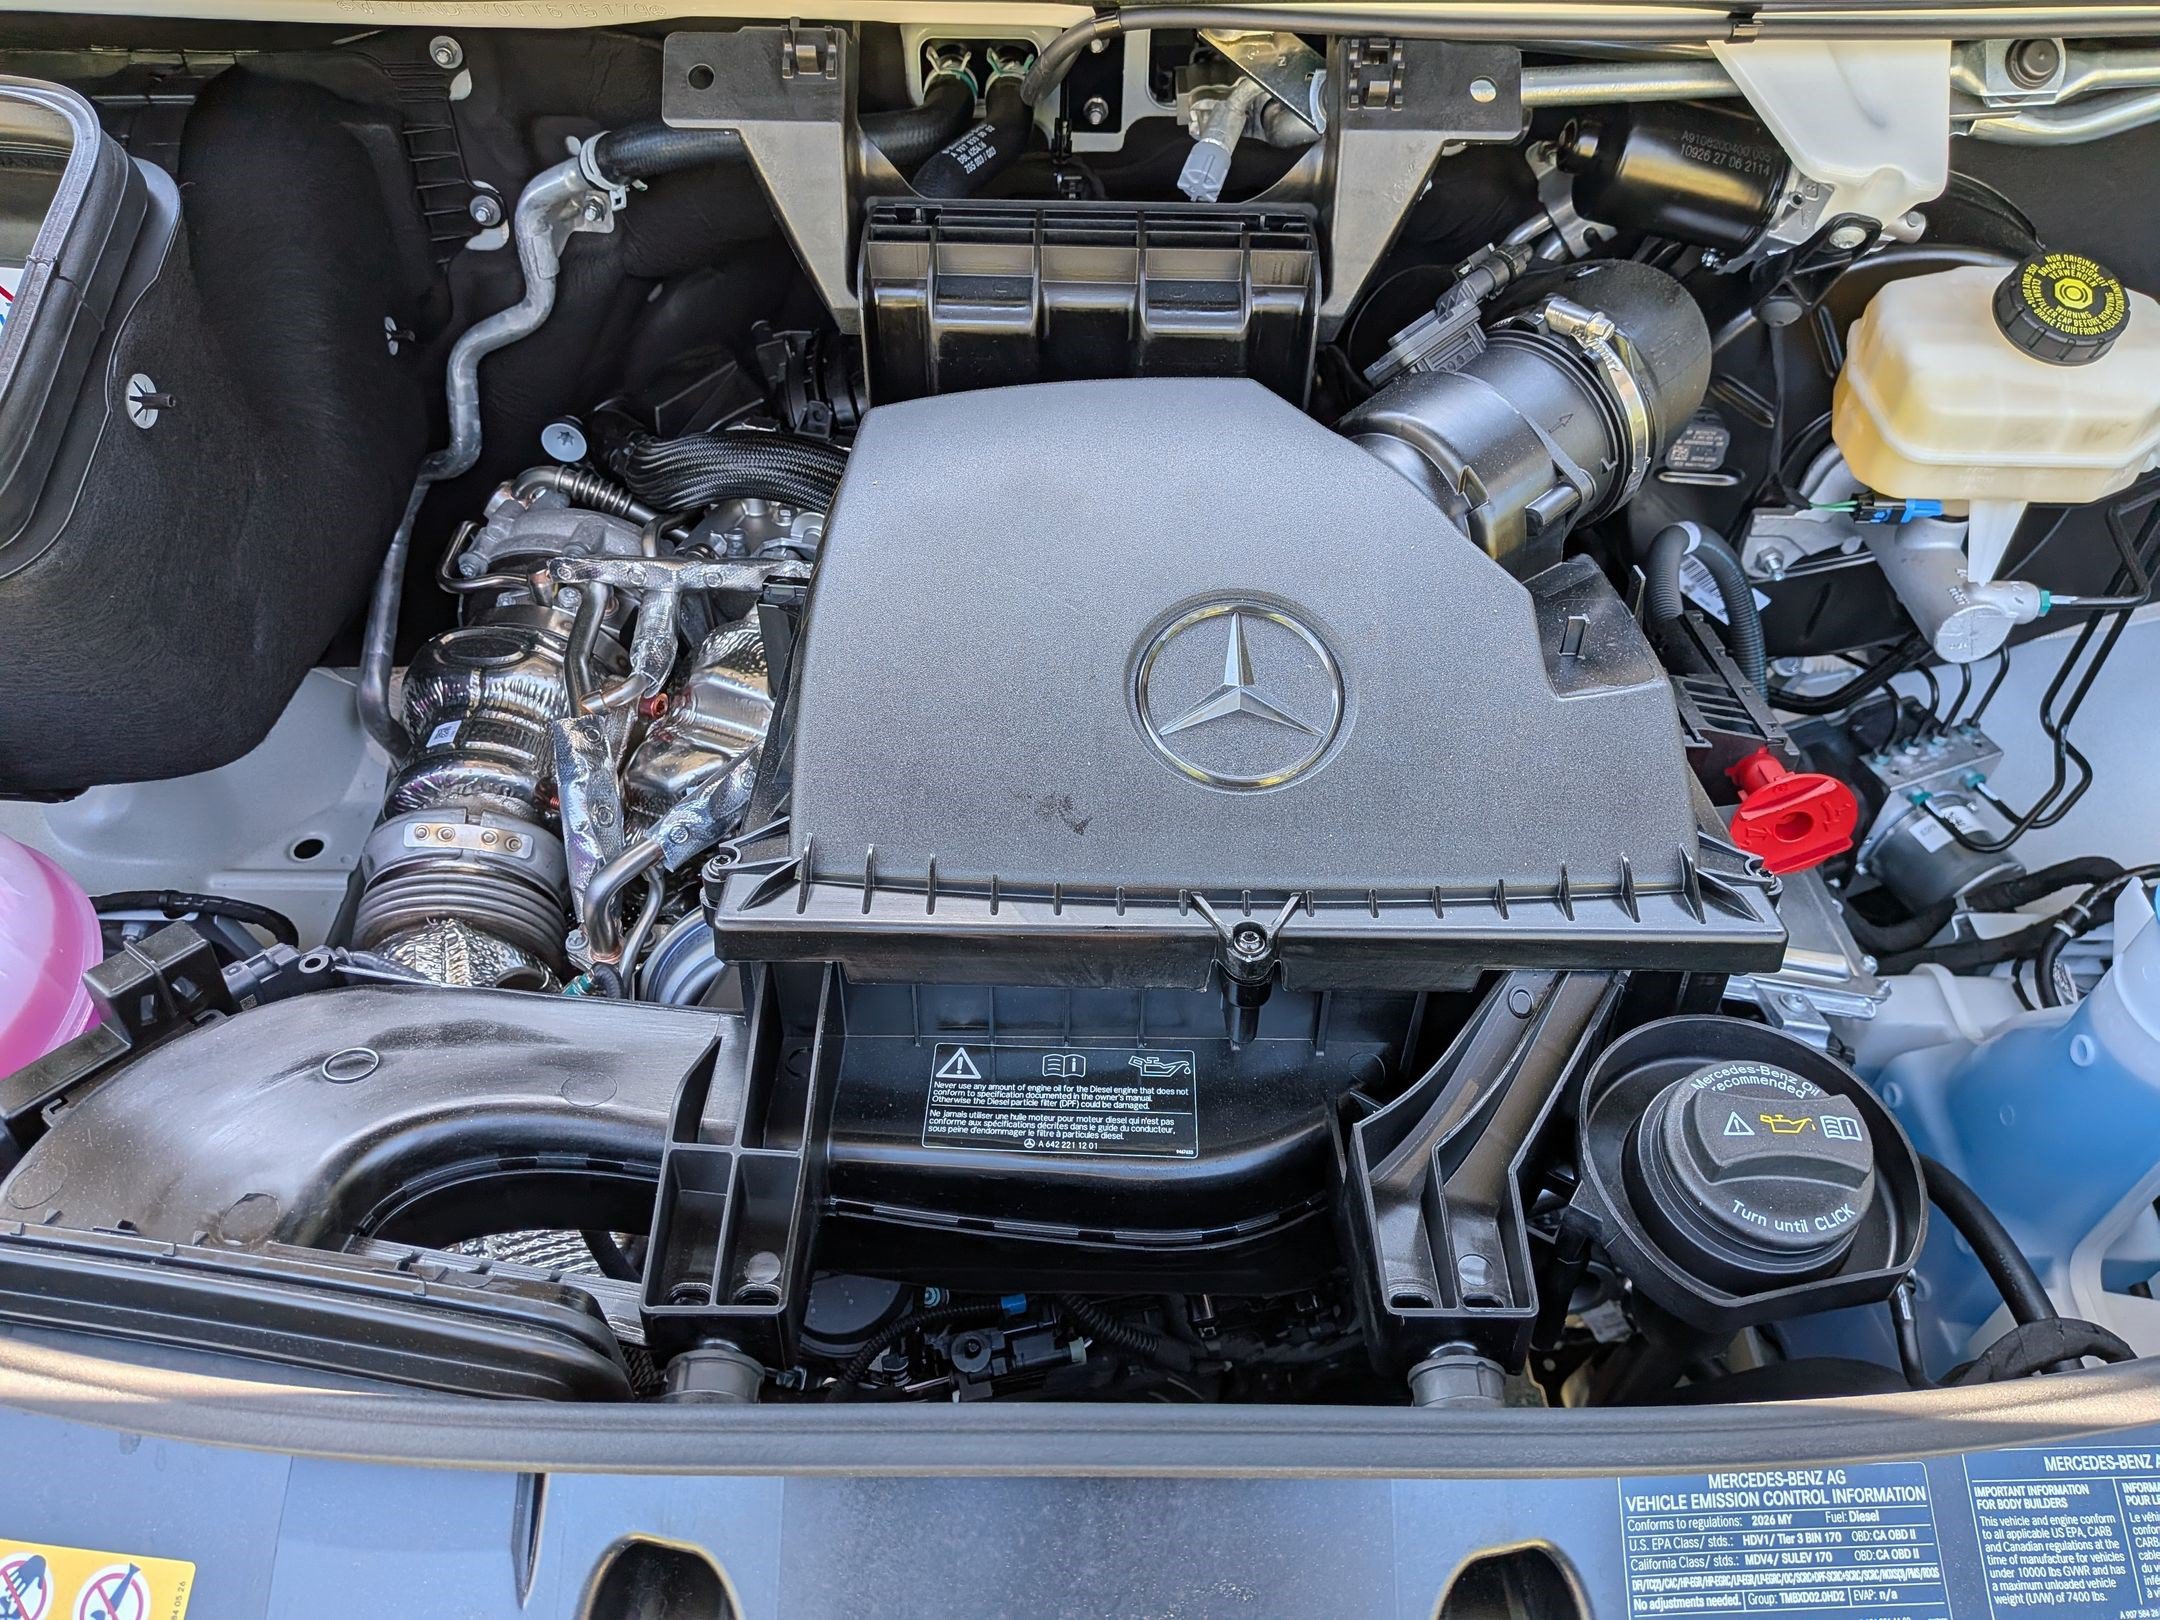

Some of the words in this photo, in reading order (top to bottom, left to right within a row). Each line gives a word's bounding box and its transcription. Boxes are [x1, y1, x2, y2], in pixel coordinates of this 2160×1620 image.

[1680, 144, 1710, 161] 10926
[1713, 152, 1727, 165] 27
[1729, 156, 1742, 169] 06
[2026, 264, 2039, 275] USE
[2045, 254, 2061, 263] NUR
[2064, 254, 2099, 272] ORIGINAL
[2022, 274, 2032, 289] ONLY
[2049, 269, 2098, 287] VERWENDEN
[2032, 279, 2042, 298] CLEAN
[2108, 279, 2124, 312] CONTAINER
[2036, 298, 2057, 318] FILLER
[2056, 305, 2091, 318] WARNING
[2099, 292, 2114, 321] REMOVING
[2034, 308, 2056, 326] BRAKE
[2058, 315, 2072, 324] CAP
[2074, 317, 2102, 327] BEFORE
[2103, 311, 2123, 330] SEALED
[2056, 322, 2078, 334] FLUID
[2079, 326, 2100, 335] FROM
[934, 1080, 956, 1088] Never
[987, 1082, 1015, 1090] amount
[1027, 1083, 1051, 1092] engine
[1089, 1085, 1112, 1093] Diesel
[1113, 1086, 1138, 1095] engine
[1691, 1065, 1798, 1091] Mercedes-Benz
[1802, 1082, 1821, 1097] Oil
[1712, 1075, 1806, 1099] recommended
[932, 1095, 971, 1103] Otherwise
[986, 1097, 1009, 1105] Diesel
[1010, 1097, 1038, 1107] particle
[1059, 1099, 1079, 1108] (DPF)
[1080, 1099, 1100, 1107] could
[1113, 1100, 1149, 1110] damaged.
[976, 1089, 1024, 1099] specification
[1025, 1090, 1071, 1099] documented
[1094, 1092, 1124, 1100] owner's
[1125, 1093, 1152, 1101] manual.
[942, 1109, 967, 1119] jamais
[968, 1110, 993, 1118] utiliser
[1028, 1112, 1055, 1121] moteur
[1076, 1114, 1103, 1123] moteur
[1105, 1115, 1127, 1123] diesel
[1140, 1117, 1159, 1125] n'est
[929, 1117, 966, 1125] conforme
[983, 1118, 1035, 1129] spécifications
[1036, 1120, 1068, 1129] décrites
[1097, 1122, 1118, 1133] guide
[1130, 1124, 1175, 1134] conducteur,
[947, 1125, 968, 1135] peine
[969, 1126, 1026, 1137] d'endommager
[1036, 1128, 1054, 1136] filtre
[1062, 1129, 1099, 1140] particules
[1100, 1130, 1124, 1139] diesel.
[1045, 1140, 1059, 1148] 642
[1731, 1200, 1766, 1226] Turn
[1774, 1220, 1808, 1233] until
[1814, 1203, 1855, 1230] CLICK
[2043, 1453, 2152, 1471] MERCEDES-BENZ
[1708, 1469, 1823, 1488] MERCEDES-BENZ
[1825, 1469, 1846, 1484] AG
[1974, 1485, 2026, 1497] IMPORTANT
[2026, 1483, 2089, 1495] INFORMATION
[1625, 1493, 1688, 1511] VEHICLE
[1689, 1491, 1760, 1508] EMISSION
[1762, 1488, 1830, 1506] CONTROL
[1831, 1485, 1926, 1503] INFORMATION
[1976, 1499, 1996, 1509] FOR
[1996, 1498, 2022, 1509] BODY
[2023, 1497, 2068, 1508] BUILDERS
[2125, 1495, 2151, 1505] POUR
[1626, 1516, 1674, 1530] Conforms
[1675, 1516, 1686, 1528] to
[1687, 1514, 1742, 1531] regulations:
[1751, 1514, 1775, 1525] 2026
[1777, 1513, 1792, 1524] MY
[1825, 1510, 1847, 1522] Fuel:
[1848, 1509, 1879, 1521] Diesel
[1979, 1515, 1998, 1526] This
[1998, 1514, 2030, 1525] vehicle
[2031, 1514, 2048, 1525] and
[2049, 1513, 2079, 1527] engine
[2079, 1512, 2116, 1524] conform
[1742, 1533, 1776, 1546] HDV1/
[1776, 1532, 1795, 1544] Tier
[1796, 1532, 1803, 1543] 3
[1804, 1532, 1822, 1543] BIN
[1824, 1531, 1842, 1542] 170
[1851, 1529, 1872, 1541] OBD:
[1872, 1529, 1887, 1540] CA
[1887, 1528, 1908, 1540] OBD
[1993, 1528, 2004, 1539] all
[2005, 1526, 2050, 1541] applicable
[2050, 1526, 2065, 1537] US
[2065, 1525, 2086, 1538] EPA,
[2086, 1525, 2112, 1536] CARB
[1628, 1538, 1649, 1550] U.S.
[1651, 1537, 1671, 1549] EPA
[1672, 1536, 1705, 1549] Class/
[1707, 1535, 1733, 1547] stds.:
[1984, 1541, 2002, 1552] and
[2002, 1539, 2044, 1551] Canadian
[2044, 1538, 2094, 1553] regulations
[2104, 1538, 2120, 1549] the
[1630, 1556, 1677, 1570] California
[1678, 1554, 1711, 1569] Class/
[1712, 1553, 1739, 1566] stds.:
[1745, 1552, 1780, 1566] MDV4/
[1781, 1551, 1812, 1563] SULEV
[1814, 1551, 1832, 1562] 170
[1854, 1549, 1875, 1561] OBD:
[1875, 1548, 1890, 1560] CA
[1890, 1548, 1911, 1559] OBD
[1986, 1554, 2007, 1565] time
[2007, 1553, 2018, 1564] of
[2018, 1552, 2075, 1564] manufacture
[2075, 1551, 2088, 1562] for
[2089, 1550, 2125, 1562] vehicles
[1989, 1566, 2015, 1577] under
[2017, 1566, 2046, 1577] 10000
[2047, 1565, 2062, 1576] lbs
[2062, 1565, 2090, 1576] GVWR
[2091, 1564, 2109, 1575] and
[2109, 1564, 2126, 1574] has
[1998, 1578, 2043, 1590] maximum
[2043, 1577, 2085, 1589] unloaded
[2085, 1576, 2116, 1588] vehicle
[1633, 1597, 1647, 1609] No
[1648, 1594, 1705, 1611] adjustments
[1705, 1592, 1741, 1606] needed.
[1748, 1592, 1777, 1607] Group:
[1853, 1588, 1876, 1600] EVAP:
[1878, 1588, 1898, 1600] n/a
[1993, 1593, 2025, 1607] weight
[2024, 1592, 2055, 1605] (UVW)
[2054, 1591, 2065, 1602] of
[2066, 1591, 2090, 1601] 7400
[2091, 1590, 2107, 1600] lbs.
